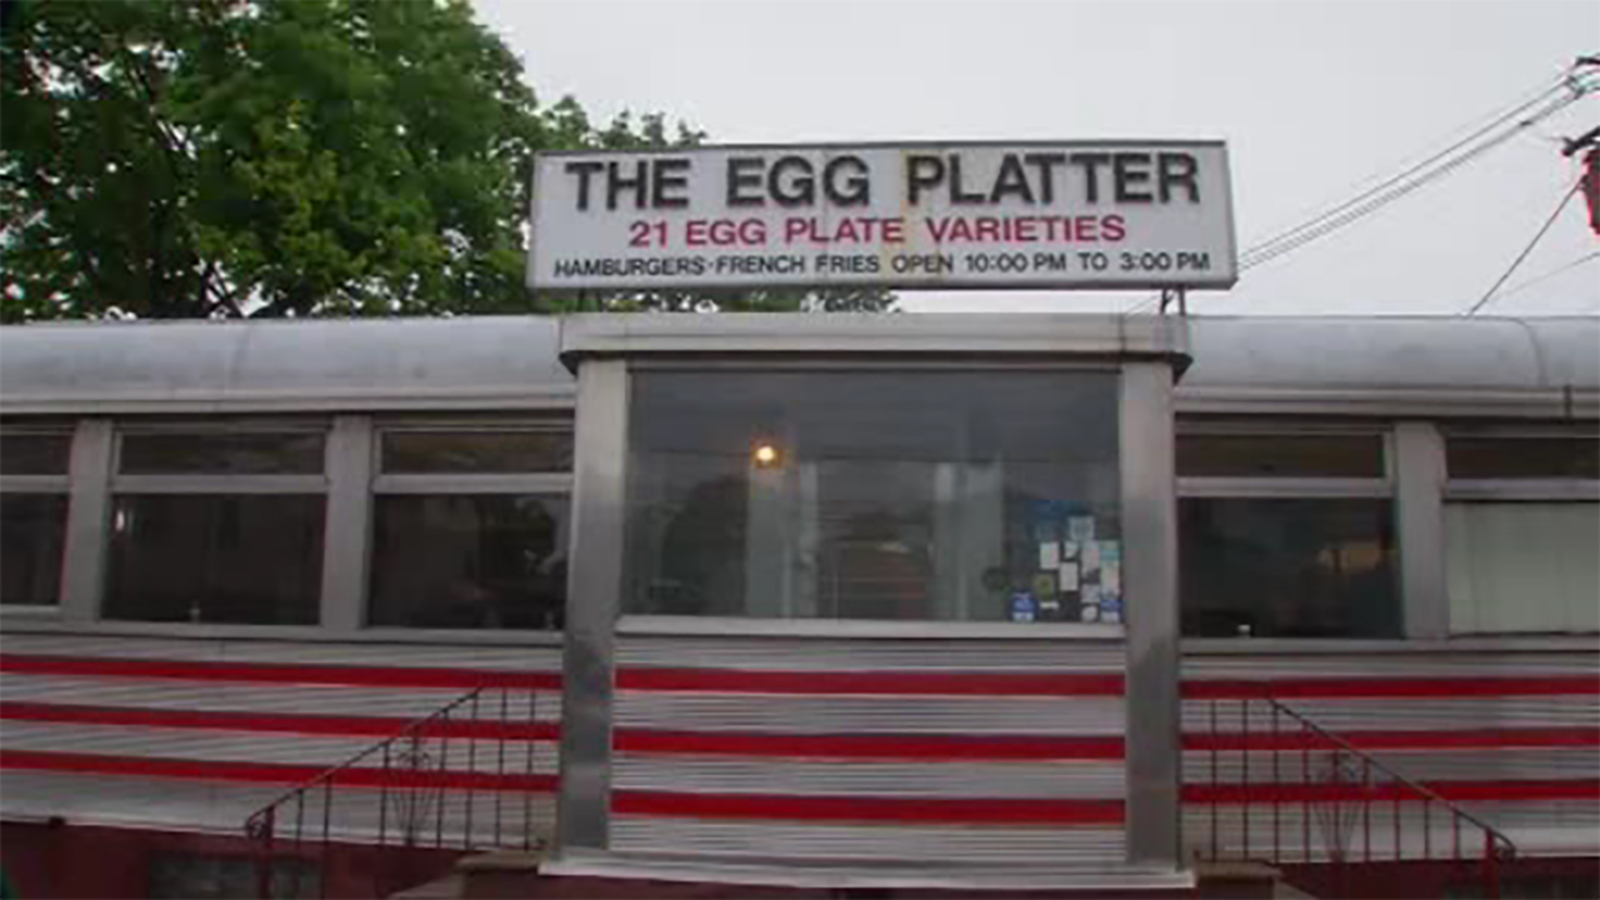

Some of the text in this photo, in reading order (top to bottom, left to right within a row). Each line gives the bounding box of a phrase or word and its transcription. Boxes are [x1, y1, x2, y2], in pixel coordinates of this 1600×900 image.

[565, 152, 1201, 211] THE EGG PLATTER
[629, 215, 1126, 247] 21 EGG PLATE VARIETIES
[815, 256, 881, 273] FRIES
[892, 254, 953, 273] OPEN
[965, 253, 1028, 272] 10:00
[1033, 253, 1066, 272] PM
[1081, 252, 1108, 271] TO
[1120, 251, 1171, 271] 3:00
[1177, 251, 1210, 270] PM
